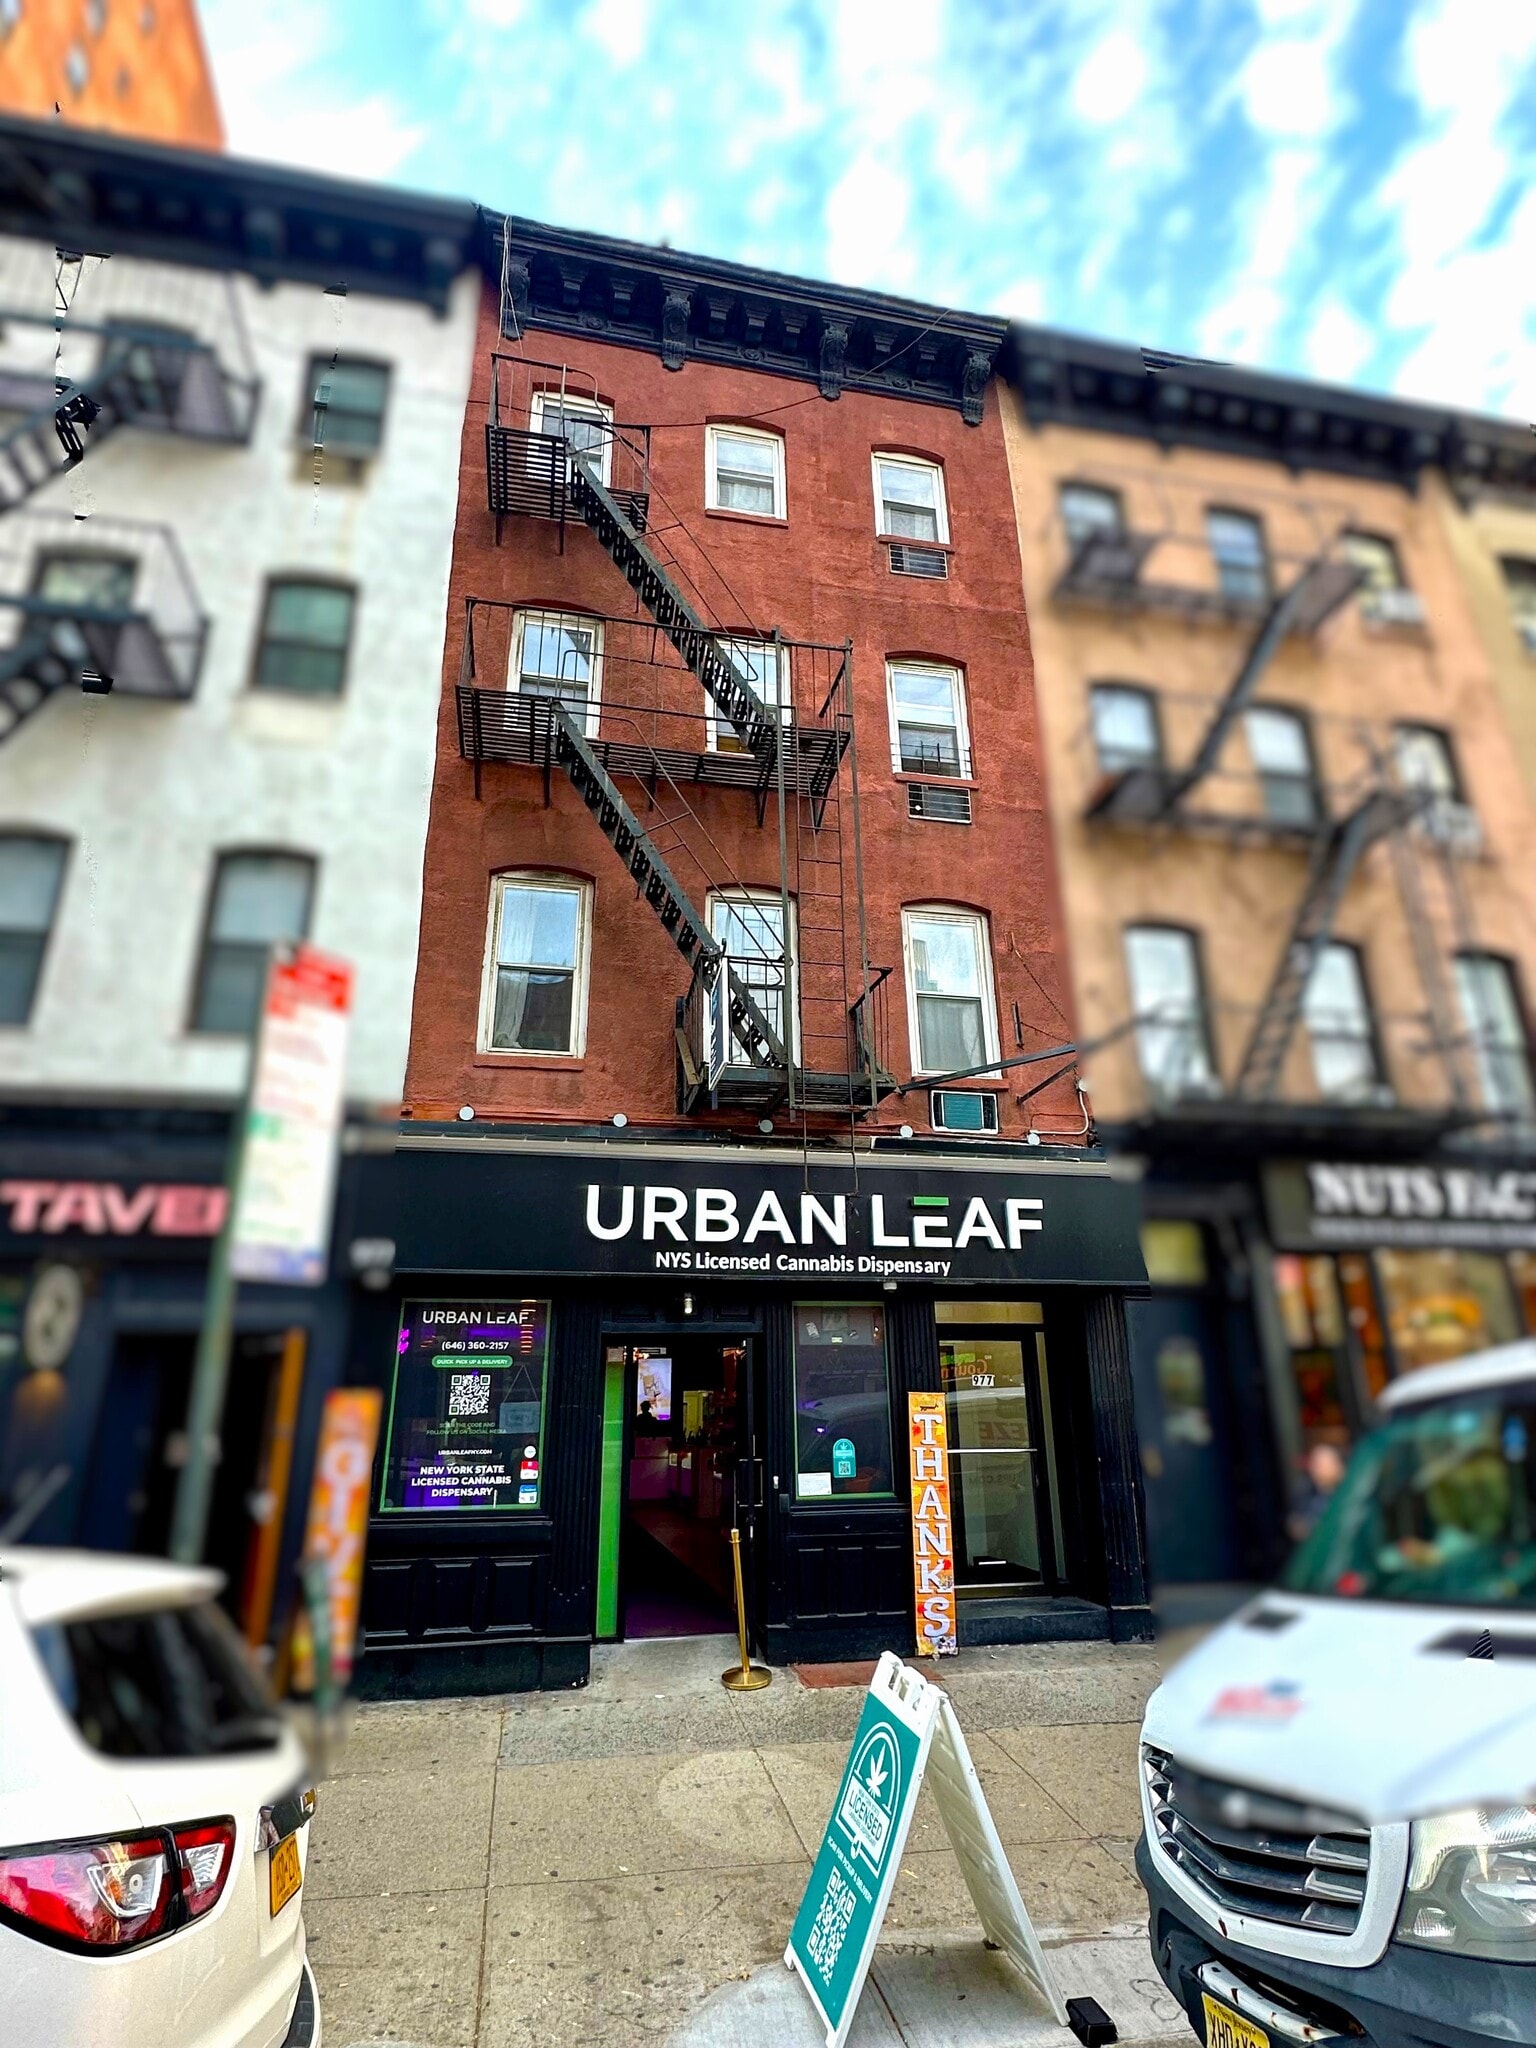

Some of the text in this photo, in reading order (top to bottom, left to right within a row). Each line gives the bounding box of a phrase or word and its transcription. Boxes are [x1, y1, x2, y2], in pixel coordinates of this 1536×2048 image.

[585, 1184, 1044, 1250] URBAN LEAF
[655, 1251, 952, 1277] NYS Licensed Cannabis Dispensary
[422, 1310, 530, 1325] URBAN LEAF
[441, 1341, 509, 1352] (646) 360-2157
[973, 1375, 994, 1386] 977
[420, 1465, 505, 1475] NEW YORK STATE
[411, 1475, 511, 1486] LICENSED CANNABIS
[431, 1487, 493, 1498] DISPENSARY
[913, 1413, 954, 1638] THANKS
[848, 1789, 883, 1842] LICENSED
